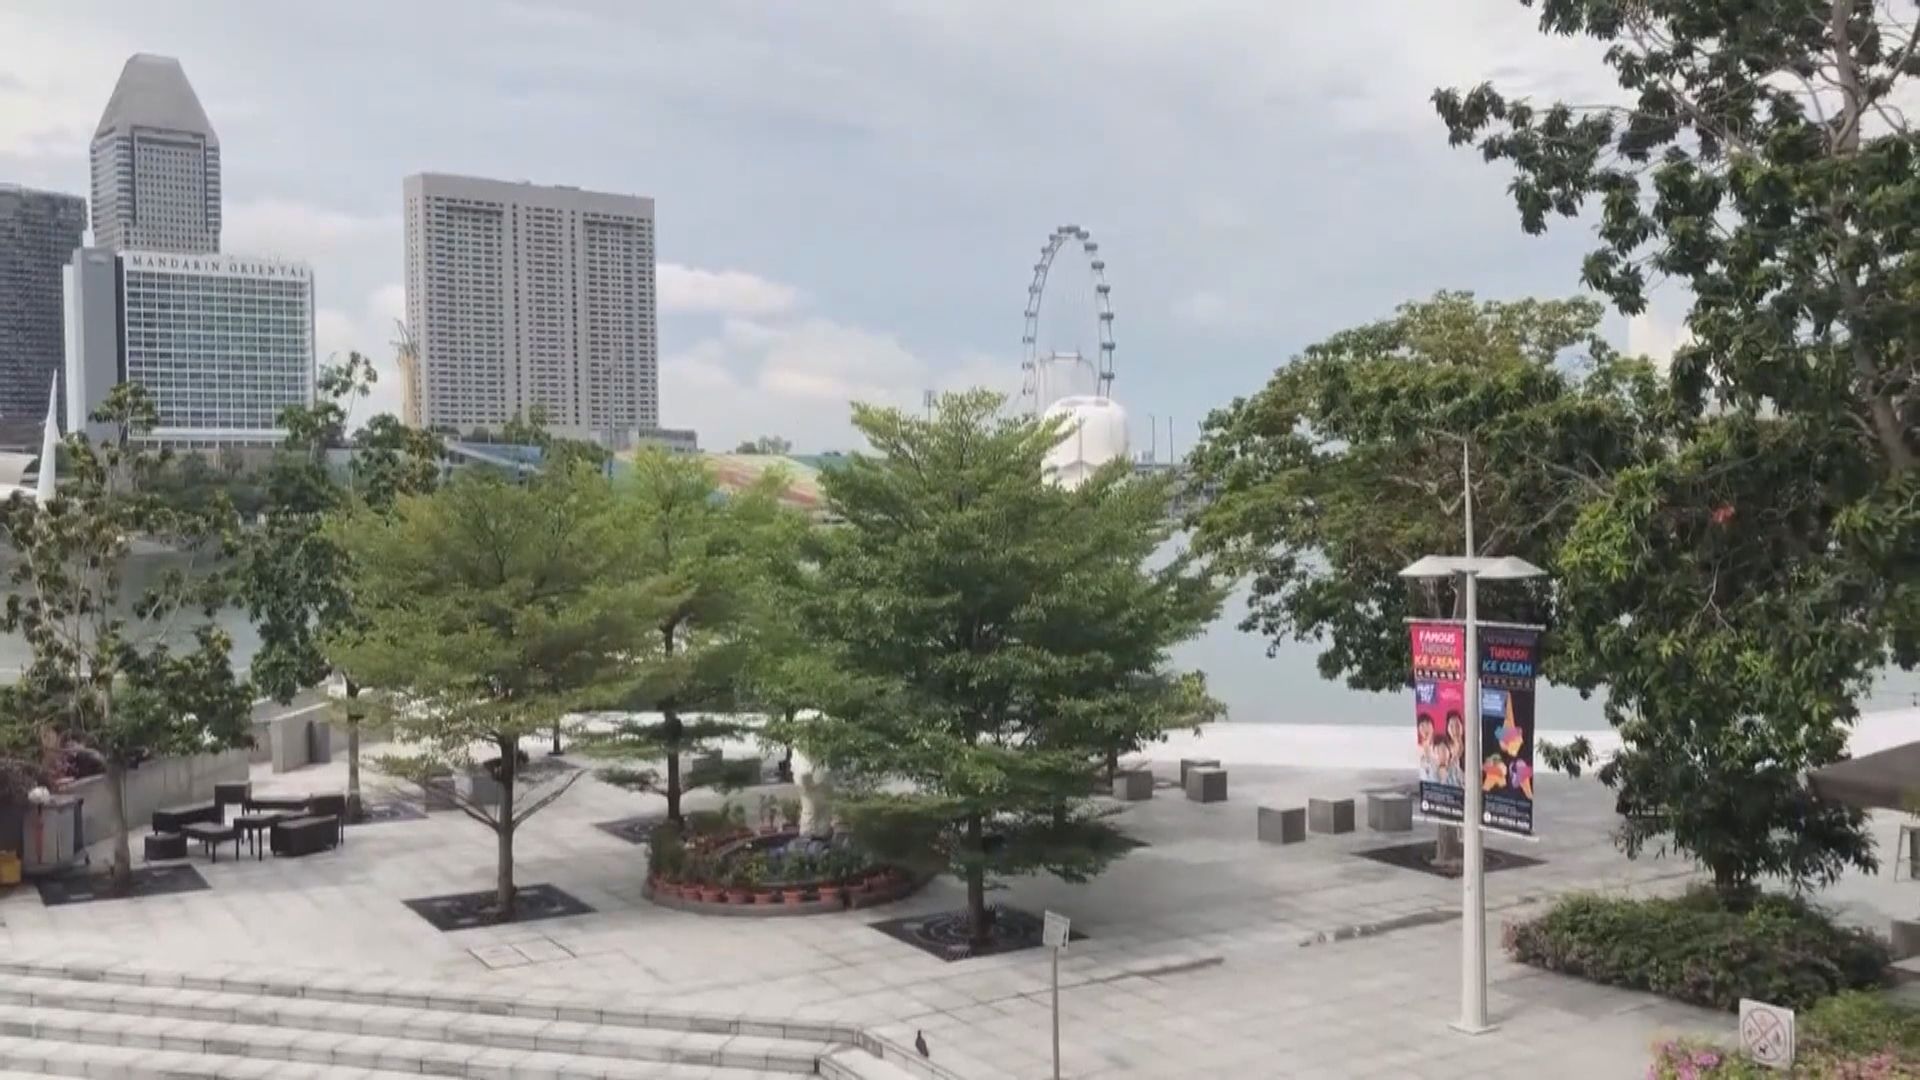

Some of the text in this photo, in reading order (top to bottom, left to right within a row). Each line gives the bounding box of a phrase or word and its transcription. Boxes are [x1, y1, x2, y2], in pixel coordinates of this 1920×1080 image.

[132, 255, 306, 278] MANDARIN ORIENTAL
[1419, 630, 1456, 643] FAMOUS
[1489, 646, 1530, 660] TURKISH
[1414, 655, 1461, 669] ICE CREAM
[1482, 659, 1532, 676] ICE CREAM
